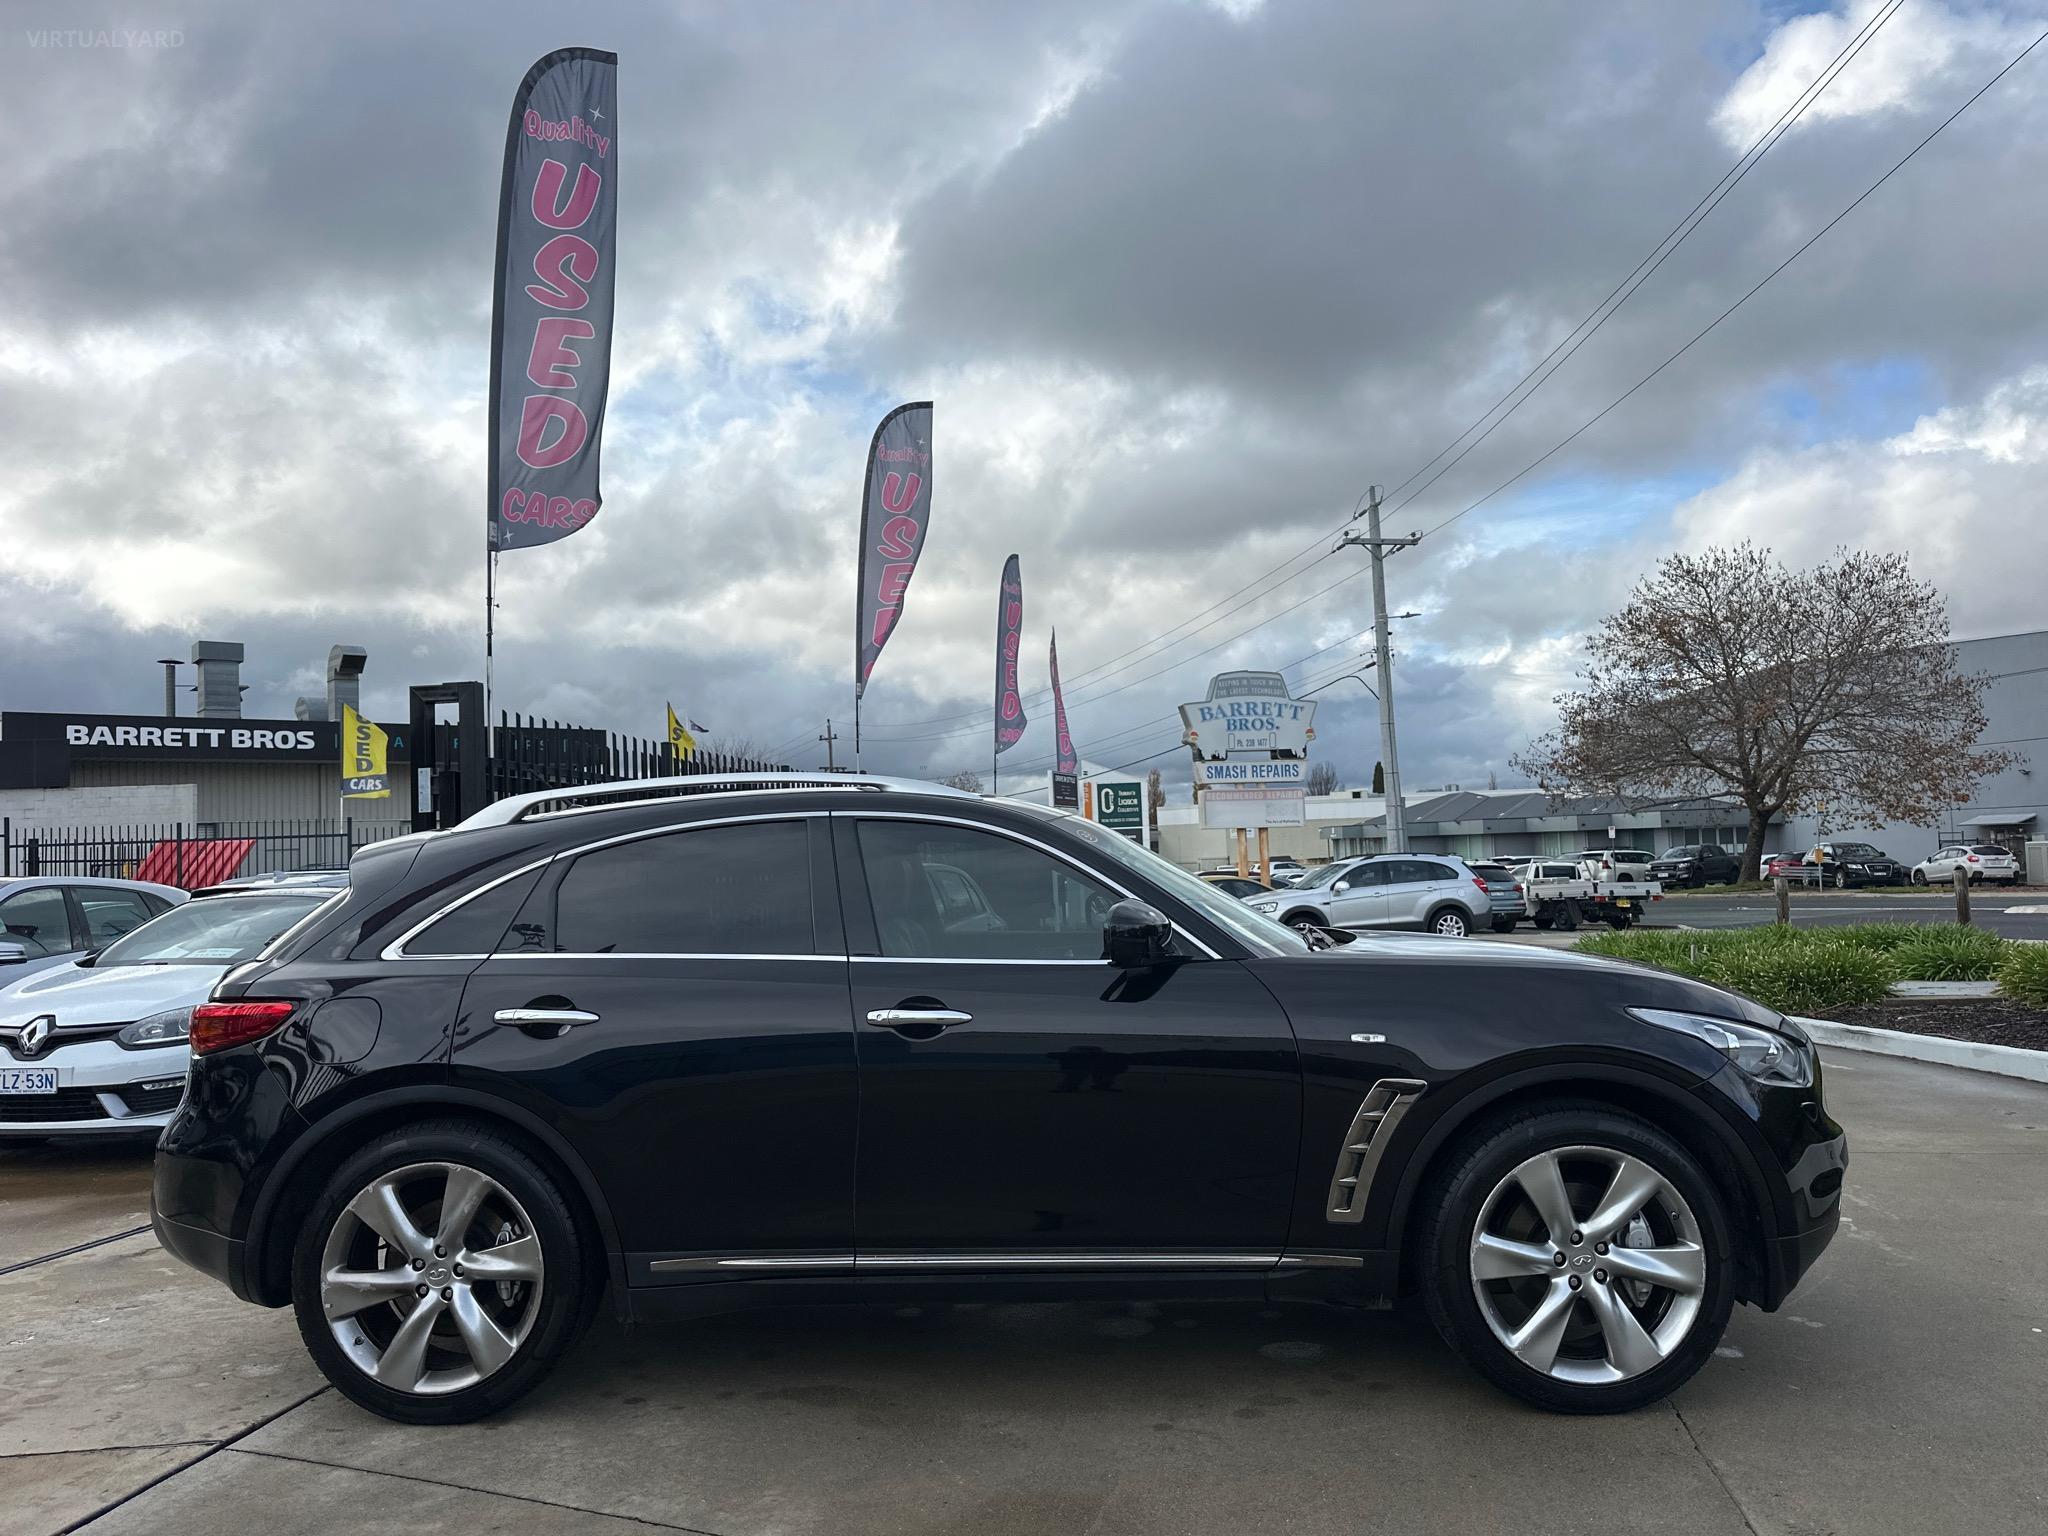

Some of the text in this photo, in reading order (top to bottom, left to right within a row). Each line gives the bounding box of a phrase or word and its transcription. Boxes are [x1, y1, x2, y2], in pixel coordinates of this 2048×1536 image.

[523, 107, 611, 159] Quality
[516, 157, 601, 470] USED
[502, 486, 599, 529] CARS
[1198, 701, 1304, 722] BARRETT
[1226, 717, 1280, 731] BROS.
[66, 725, 225, 748] BARRETT
[231, 729, 315, 750] BROS
[1206, 764, 1299, 779] SMASH REPAIRS
[350, 778, 383, 791] CARS
[1206, 790, 1303, 801] RECOMMENDED REPAIRER
